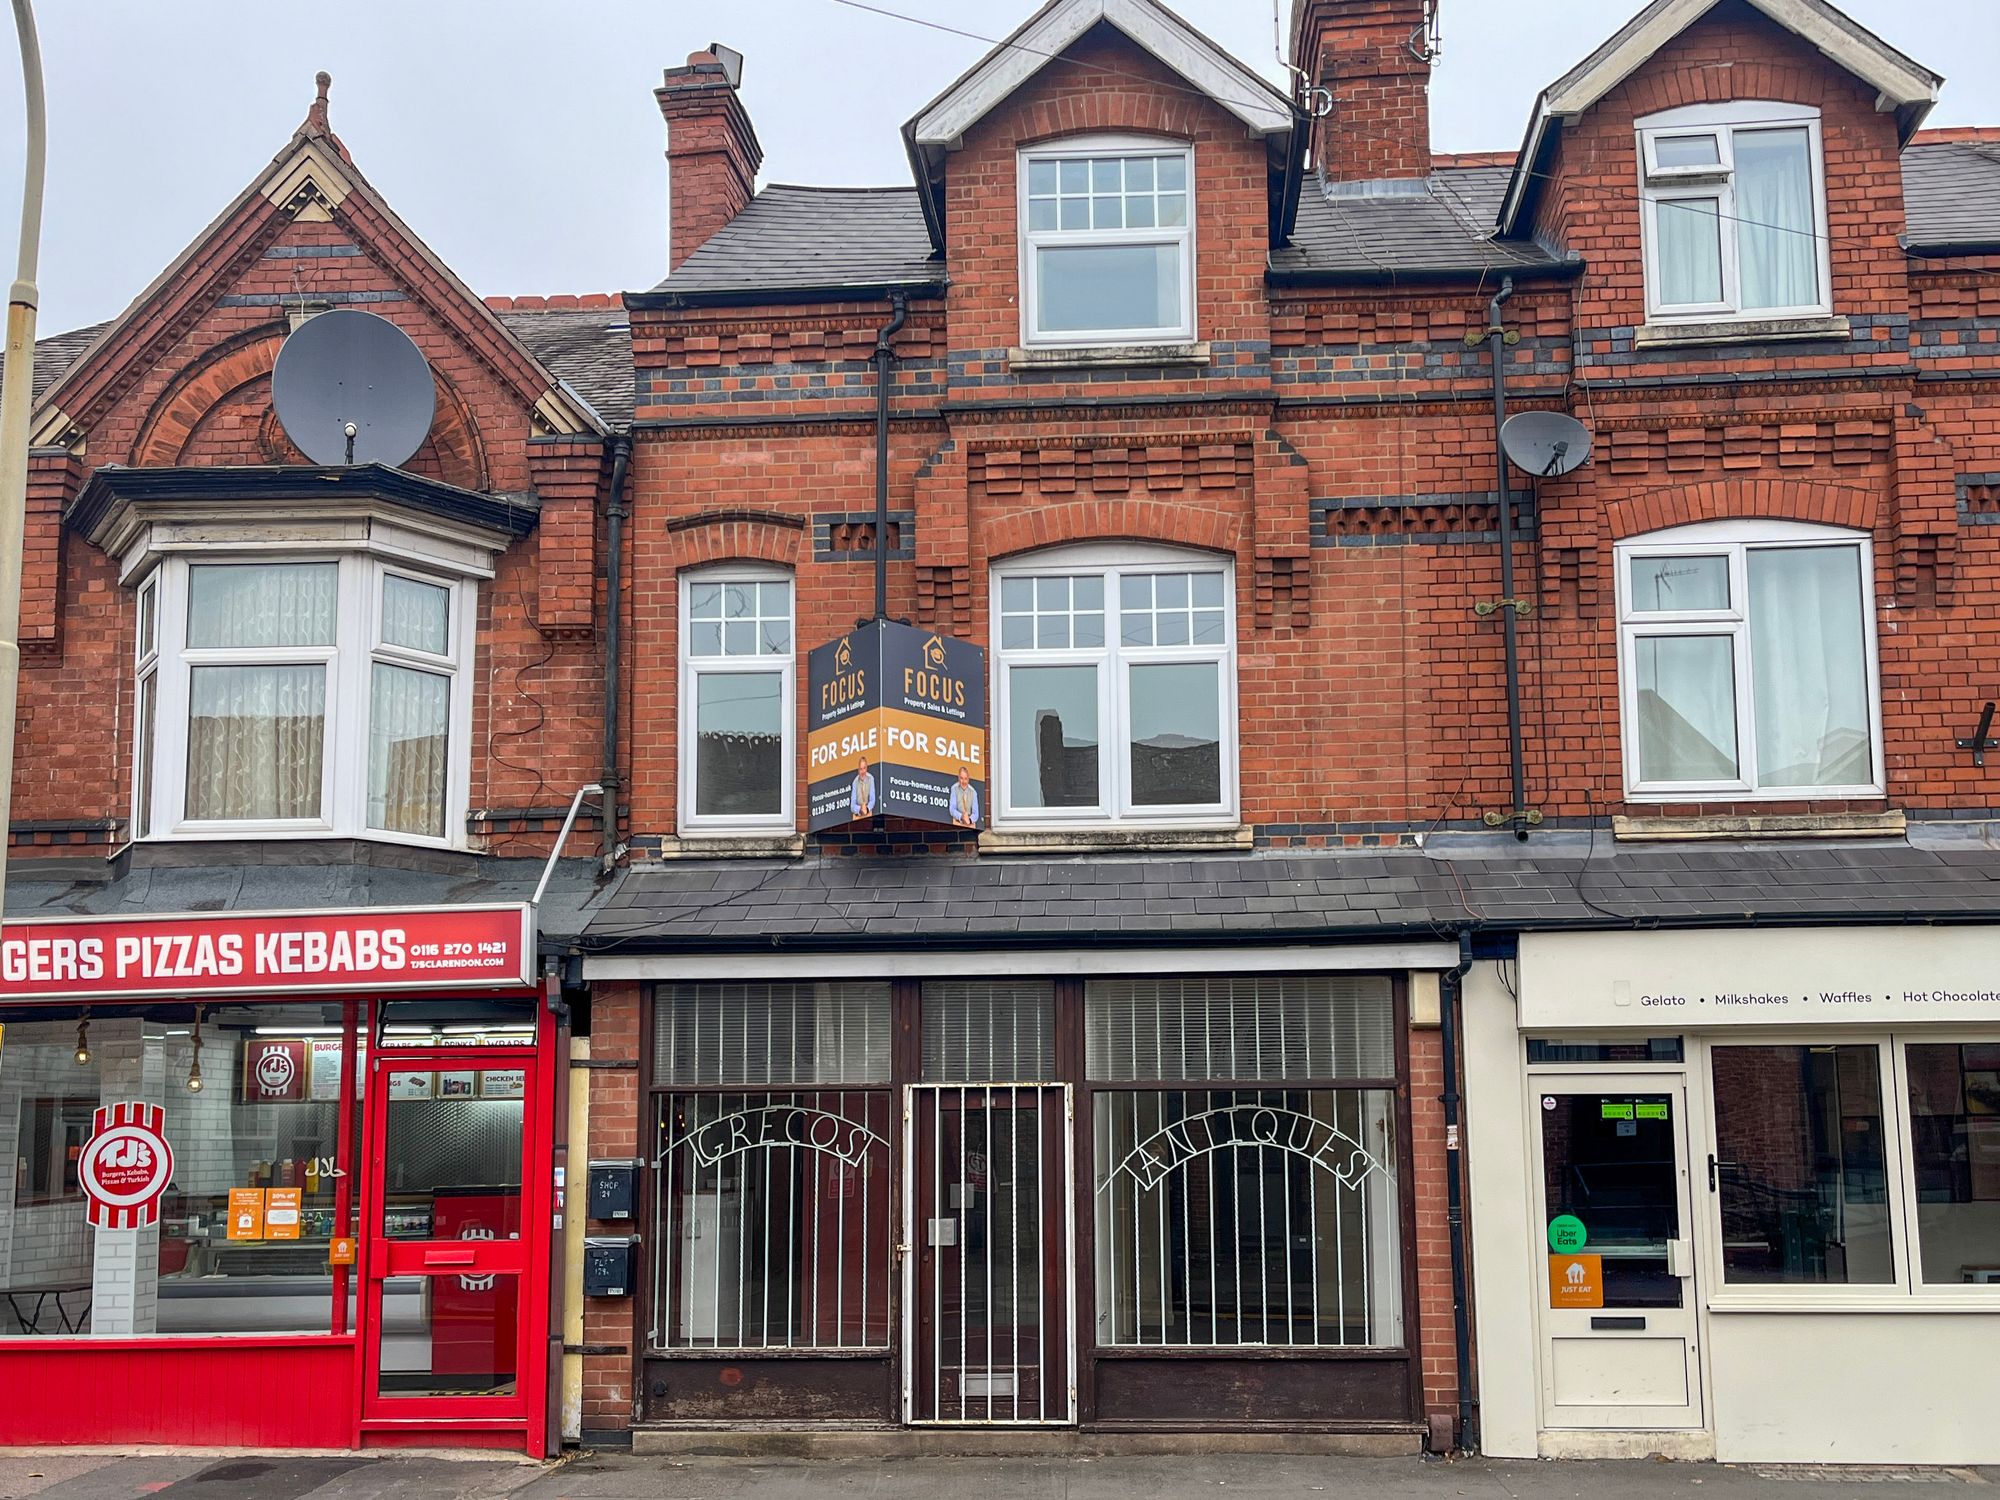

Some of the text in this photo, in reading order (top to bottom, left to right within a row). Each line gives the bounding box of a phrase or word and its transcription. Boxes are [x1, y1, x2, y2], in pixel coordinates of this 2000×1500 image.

[823, 669, 865, 710] FOCUS
[904, 668, 965, 706] FOCUS
[904, 697, 926, 710] Property
[927, 702, 941, 713] Sales
[946, 707, 966, 719] Lettings
[811, 727, 877, 768] FOR SALE
[887, 726, 980, 765] FOR SALE
[889, 777, 950, 794] Focus-homes.co.uk
[890, 790, 948, 808] 0116 296 1000
[1, 928, 407, 982] GERS PIZZAS KEBABS
[410, 941, 507, 956] 0116 270 1421
[410, 957, 505, 970] TJSCLARENDON.COM
[1640, 989, 2000, 1007] Gelato Milkshakes Waffles Hot Chocolate
[699, 1108, 867, 1161] GRECOS
[1138, 1109, 1368, 1187] ANTIQUES
[304, 1156, 347, 1178] حلال
[127, 1175, 150, 1183] Turkish
[1556, 1229, 1577, 1237] Uber
[1557, 1238, 1578, 1246] Eats
[1560, 1286, 1577, 1294] JUST
